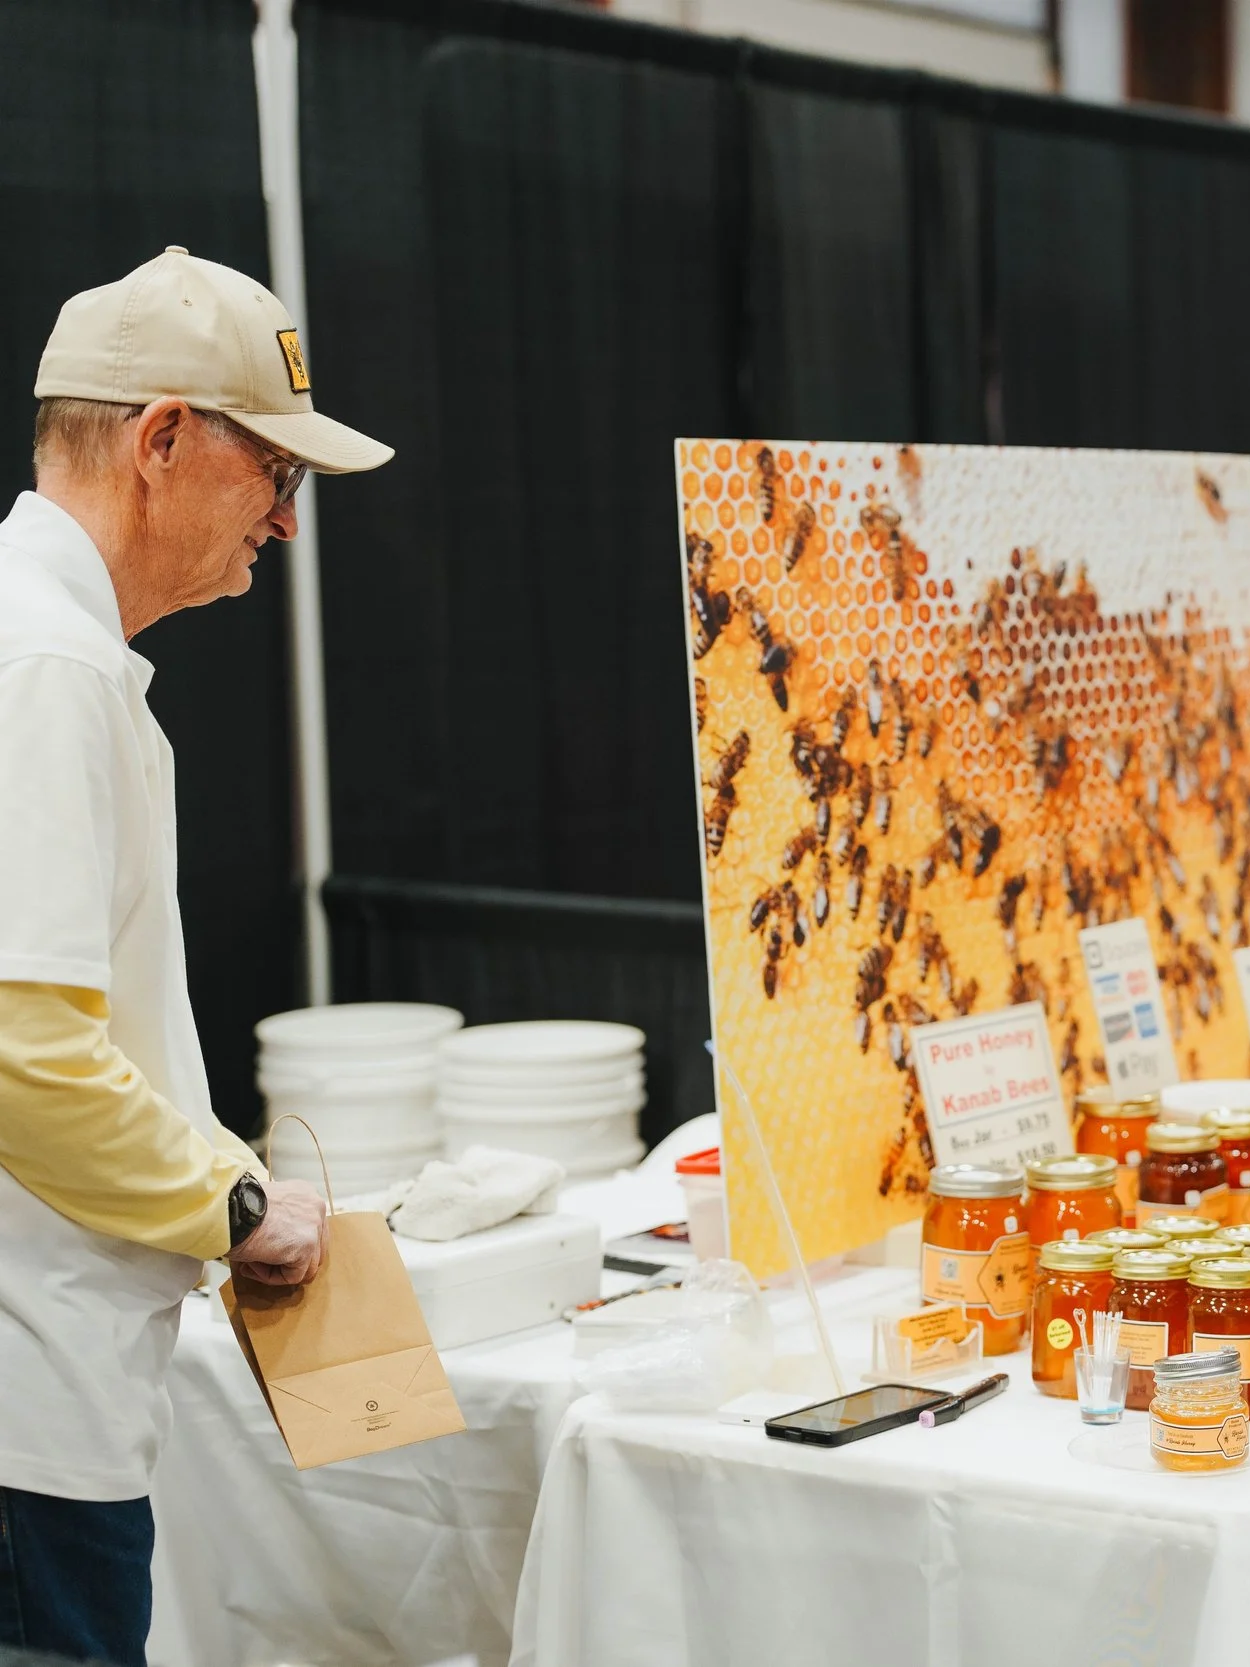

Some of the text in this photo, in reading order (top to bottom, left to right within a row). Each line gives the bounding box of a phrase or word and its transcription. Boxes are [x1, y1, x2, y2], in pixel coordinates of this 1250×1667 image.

[929, 1029, 1035, 1065] Pure Honey
[941, 1075, 1050, 1117] Kanab Bees
